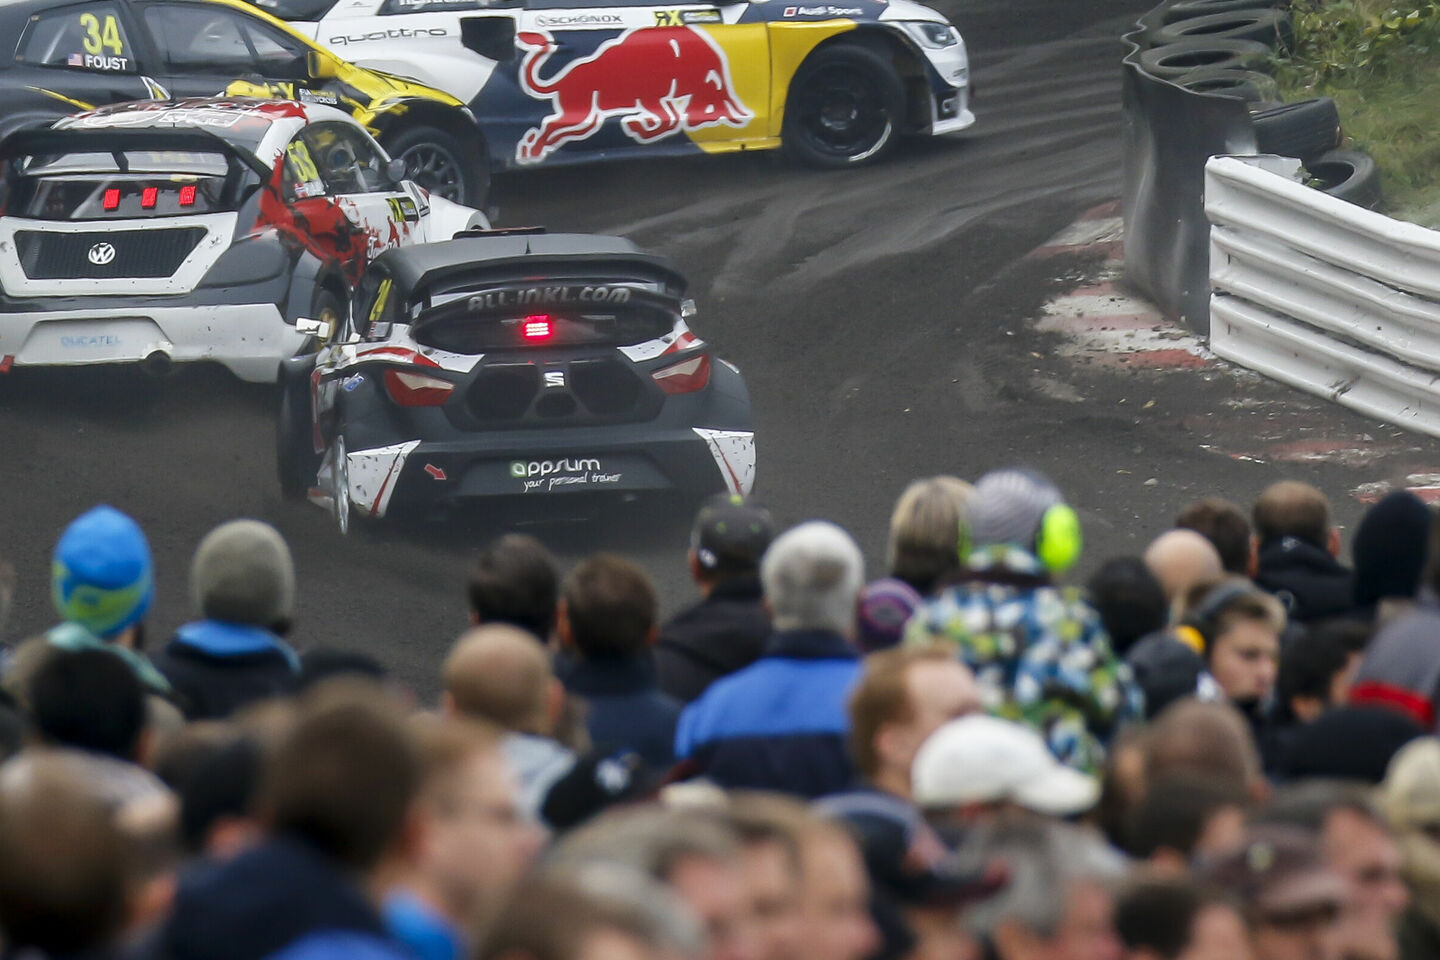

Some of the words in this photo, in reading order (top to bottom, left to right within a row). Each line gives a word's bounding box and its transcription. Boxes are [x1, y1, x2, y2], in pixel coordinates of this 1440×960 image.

[80, 12, 124, 56] 34
[329, 26, 448, 46] quattro
[84, 54, 128, 71] FOUST
[511, 458, 601, 478] appslim
[523, 478, 546, 493] your
